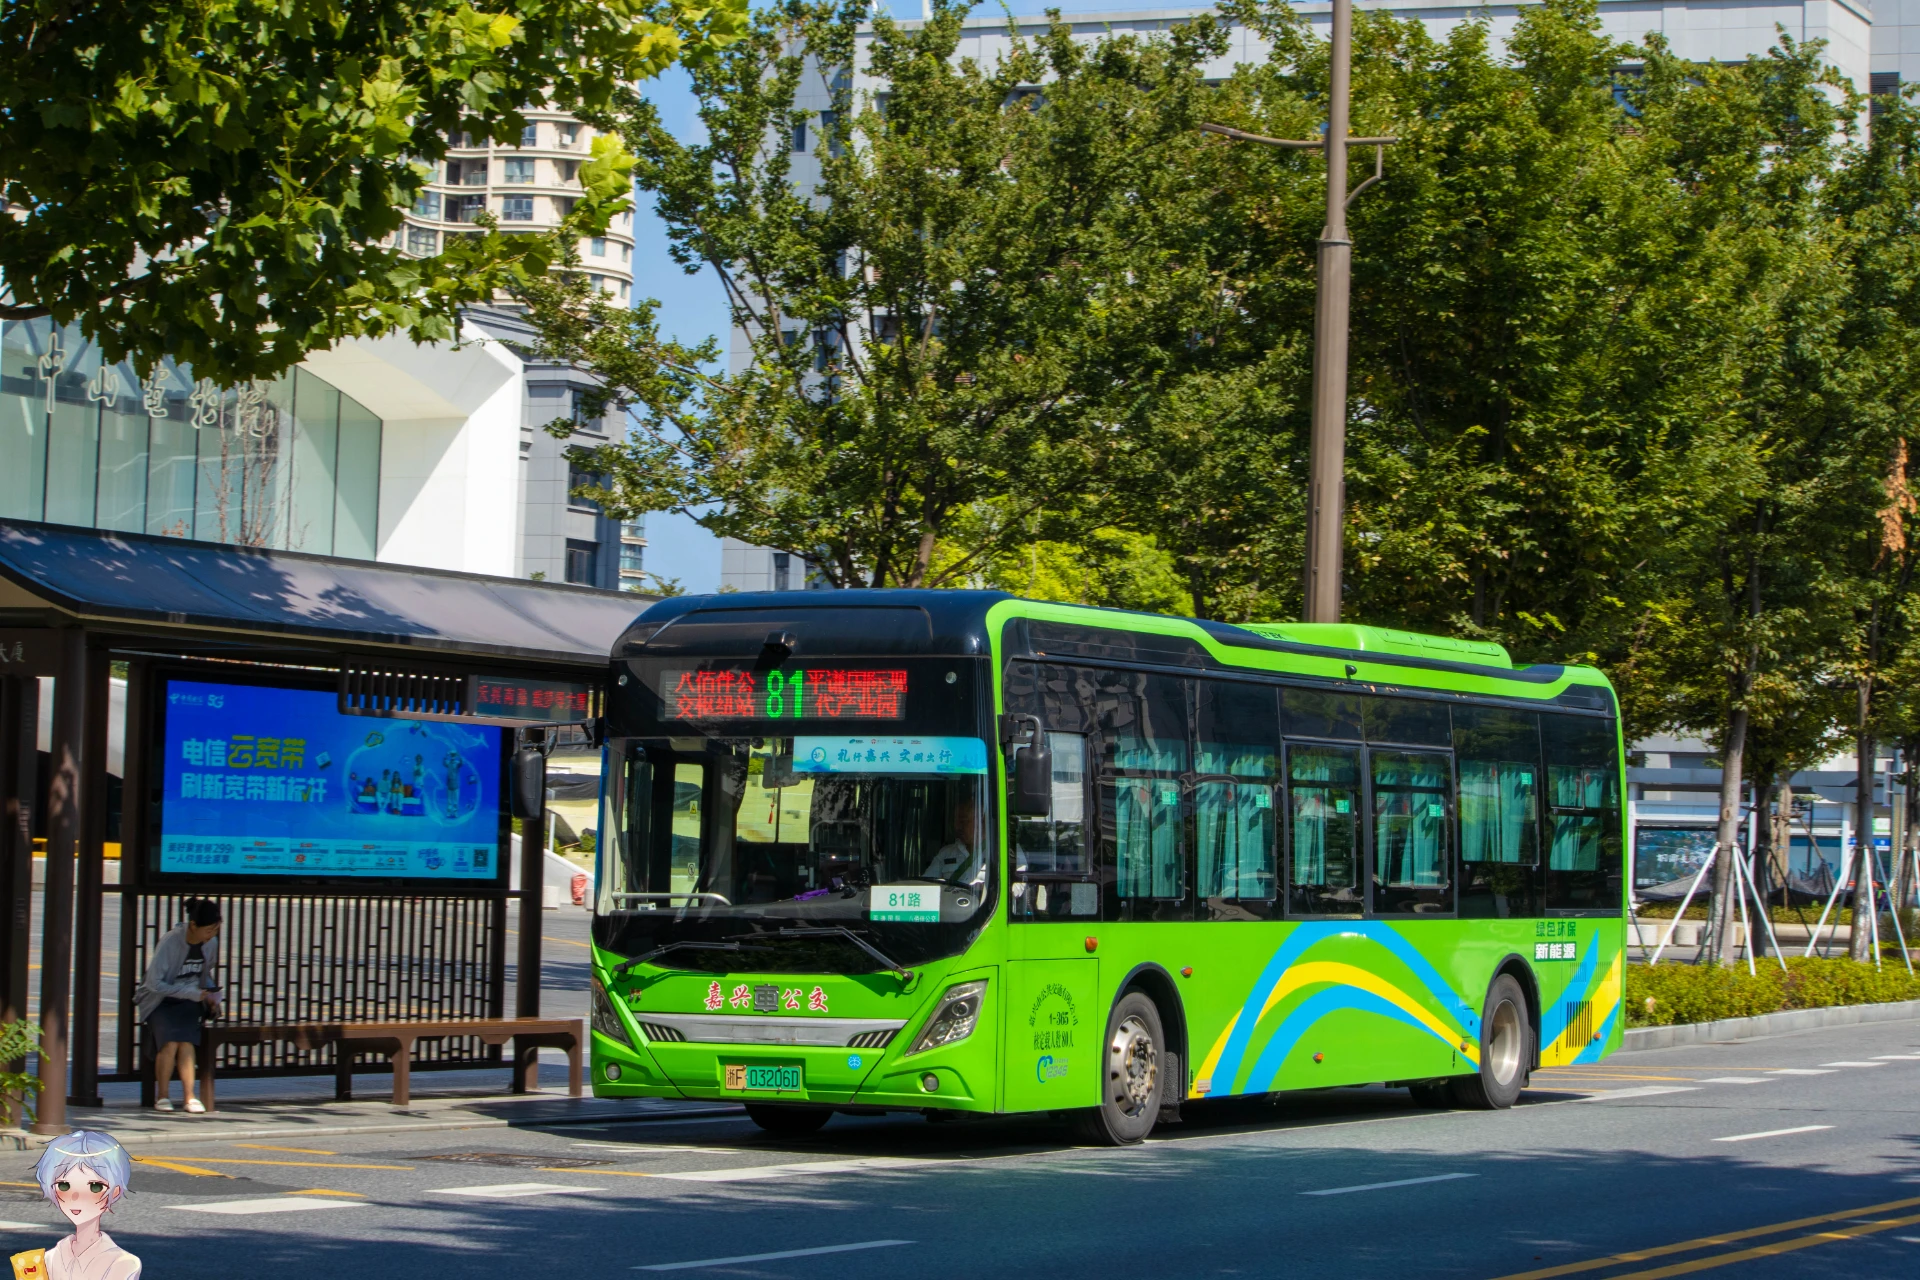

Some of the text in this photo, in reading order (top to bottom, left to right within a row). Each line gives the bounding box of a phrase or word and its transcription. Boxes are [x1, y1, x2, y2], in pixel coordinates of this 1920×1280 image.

[207, 693, 225, 709] 5G
[766, 669, 803, 718] 81
[815, 691, 898, 718] 代产业园
[675, 694, 756, 719] 交枢纽站
[182, 734, 306, 769] 电信云宽带
[899, 748, 953, 764] 文明出行
[181, 772, 328, 802] 刷新宽带新标杆
[888, 892, 921, 907] 81路
[1536, 921, 1576, 937] 绿色环保
[1535, 943, 1576, 959] 新能源
[704, 980, 829, 1012] 嘉兴 公交
